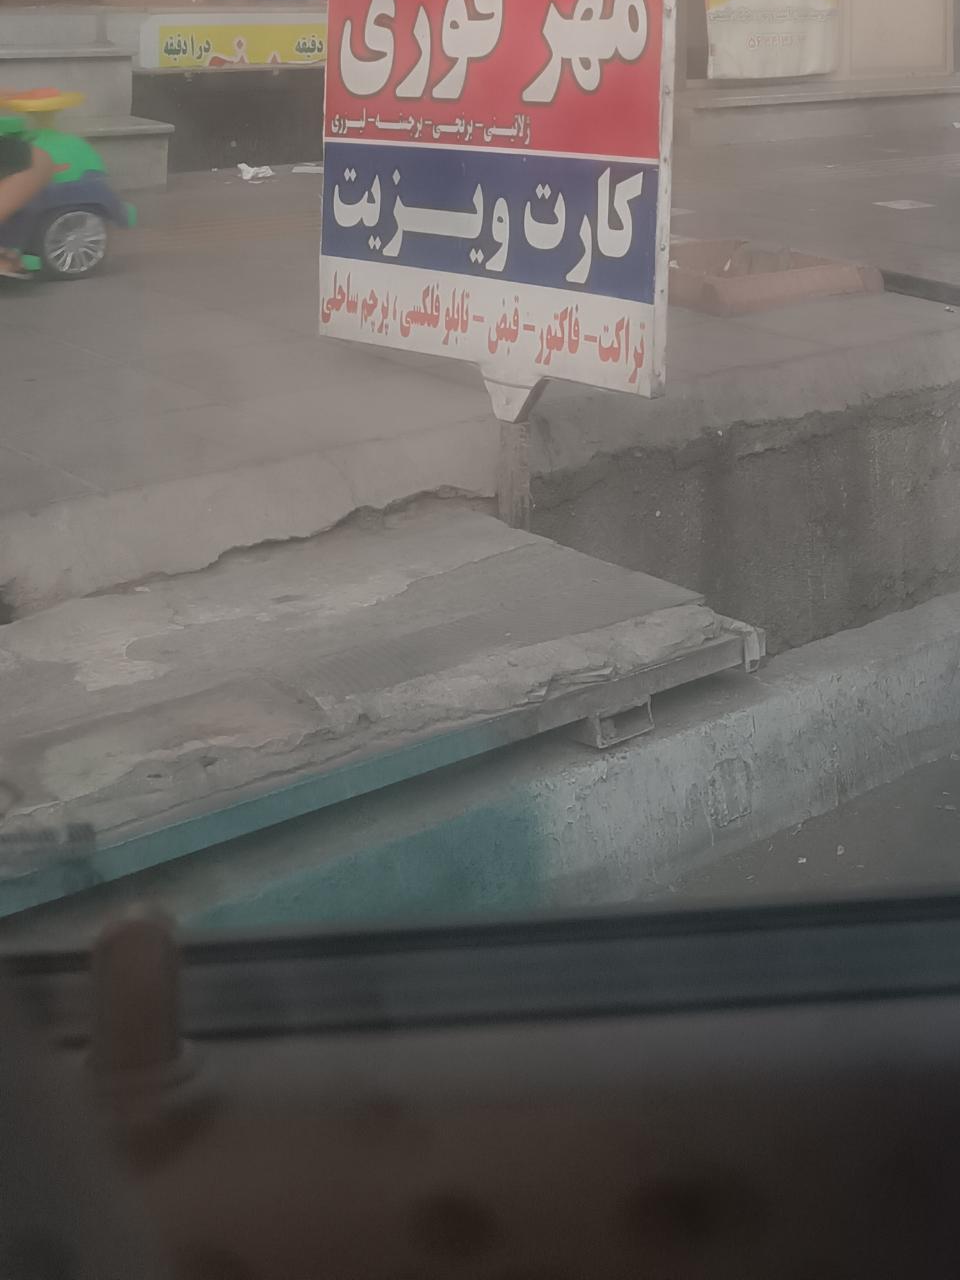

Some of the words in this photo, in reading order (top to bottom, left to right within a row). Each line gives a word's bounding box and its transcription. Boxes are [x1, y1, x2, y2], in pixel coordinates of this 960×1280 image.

[331, 107, 366, 134] لیزری
[432, 111, 473, 141] برنجی
[333, 167, 510, 272] ویزیت
[523, 167, 644, 284] کارت
[321, 269, 359, 326] ساحلی
[361, 287, 390, 336] پرچم
[442, 287, 470, 345] تابلو
[487, 296, 521, 355] قبض
[534, 304, 580, 365] فاکتور
